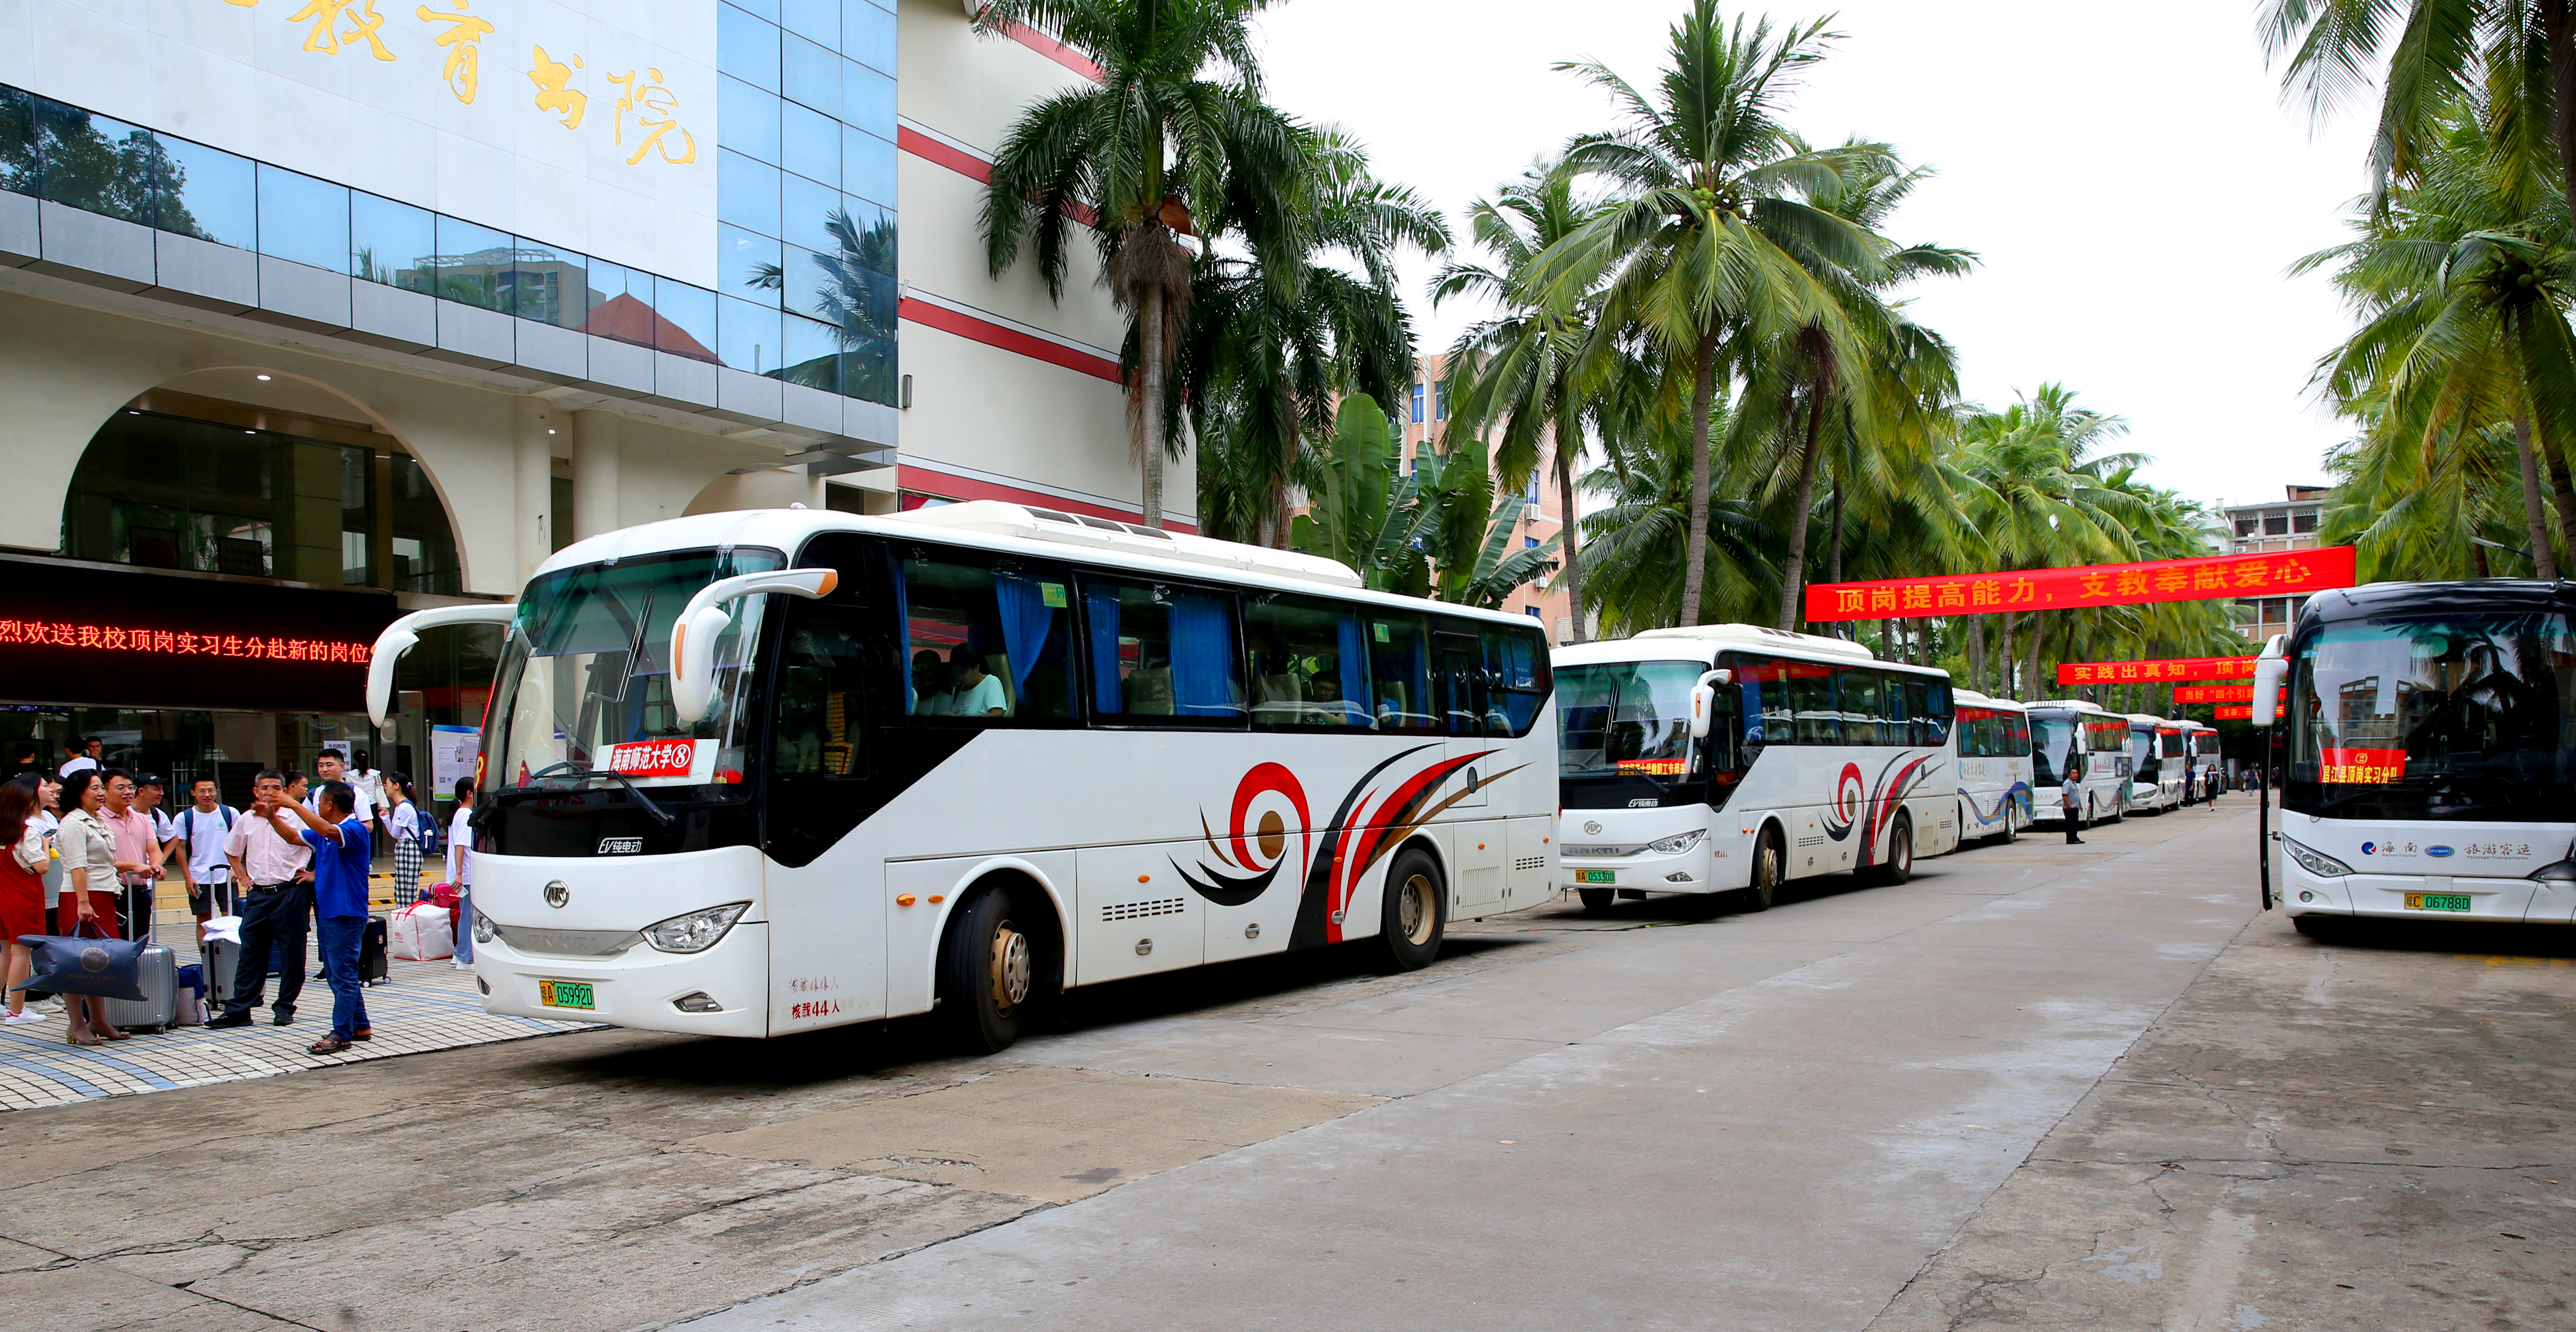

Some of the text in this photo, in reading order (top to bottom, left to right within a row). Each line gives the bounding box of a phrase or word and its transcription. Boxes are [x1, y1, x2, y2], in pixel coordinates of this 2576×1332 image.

[224, 0, 696, 165] 教育书院
[1836, 558, 2311, 613] 顶岗提高能力，支教奉献爱心
[0, 620, 369, 663] 烈欢送我校顶岗实习生分赴新的岗位
[528, 934, 599, 950] ANKAI
[792, 999, 840, 1020] 核载44人
